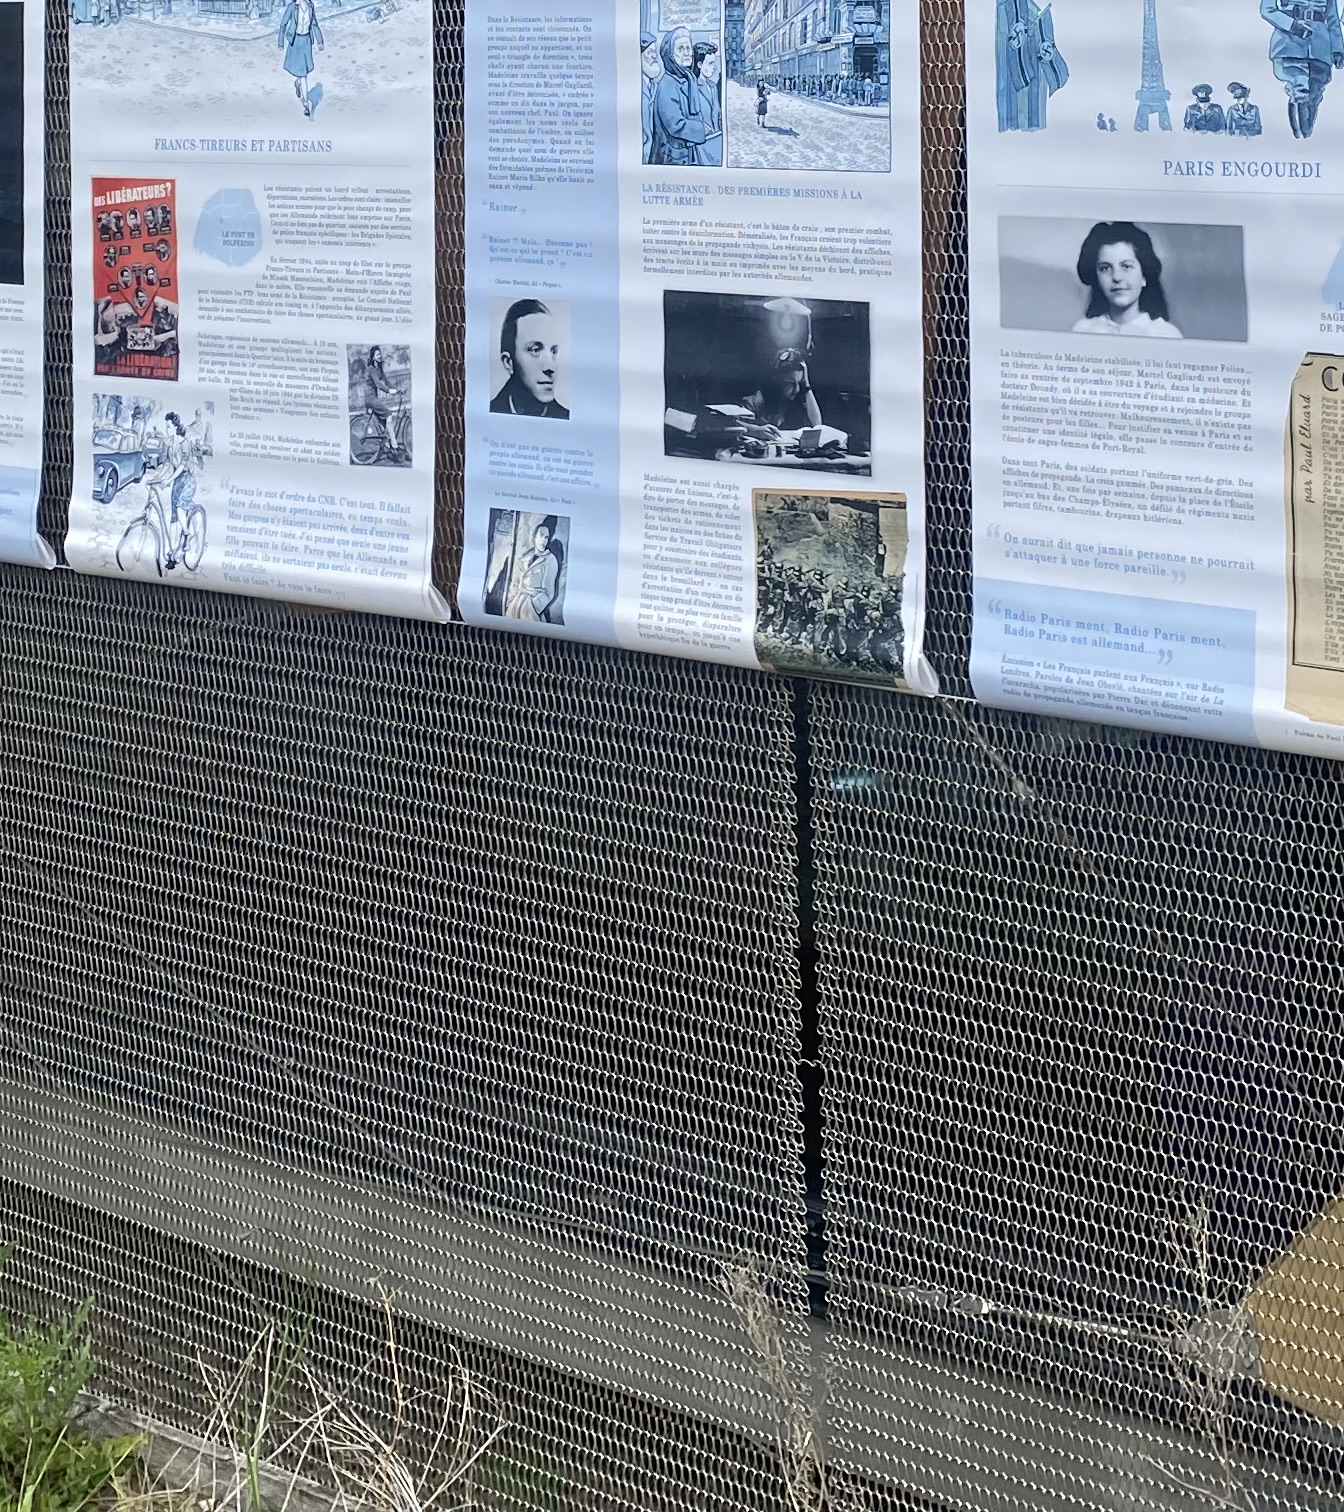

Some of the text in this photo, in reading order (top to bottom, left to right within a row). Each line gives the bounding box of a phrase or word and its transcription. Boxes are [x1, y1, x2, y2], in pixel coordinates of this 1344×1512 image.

[154, 138, 333, 152] FRANCS-TIREURS ET PARTISANS
[1162, 160, 1321, 177] PARIS ENGOURDI
[641, 181, 862, 199] LA RÉSISTANCE DES PREMIÈRES MISSIONS À LA
[642, 193, 703, 205] LUTTE ARMÉE
[94, 196, 105, 206] DES
[1320, 324, 1332, 332] DE
[1299, 393, 1313, 439] Eluard
[1300, 444, 1313, 473] Paul
[1004, 531, 1255, 574] On aurait dit que jamais personne ne pourrait
[1004, 546, 1058, 567] s'attaquer
[1060, 553, 1067, 565] à
[1070, 557, 1090, 567] une
[1093, 556, 1120, 571] force
[1004, 607, 1225, 651] Radio Paris ment, Radio Paris ment,
[1004, 622, 1034, 638] Radio
[1038, 627, 1067, 642] Paris
[1070, 632, 1087, 645] est
